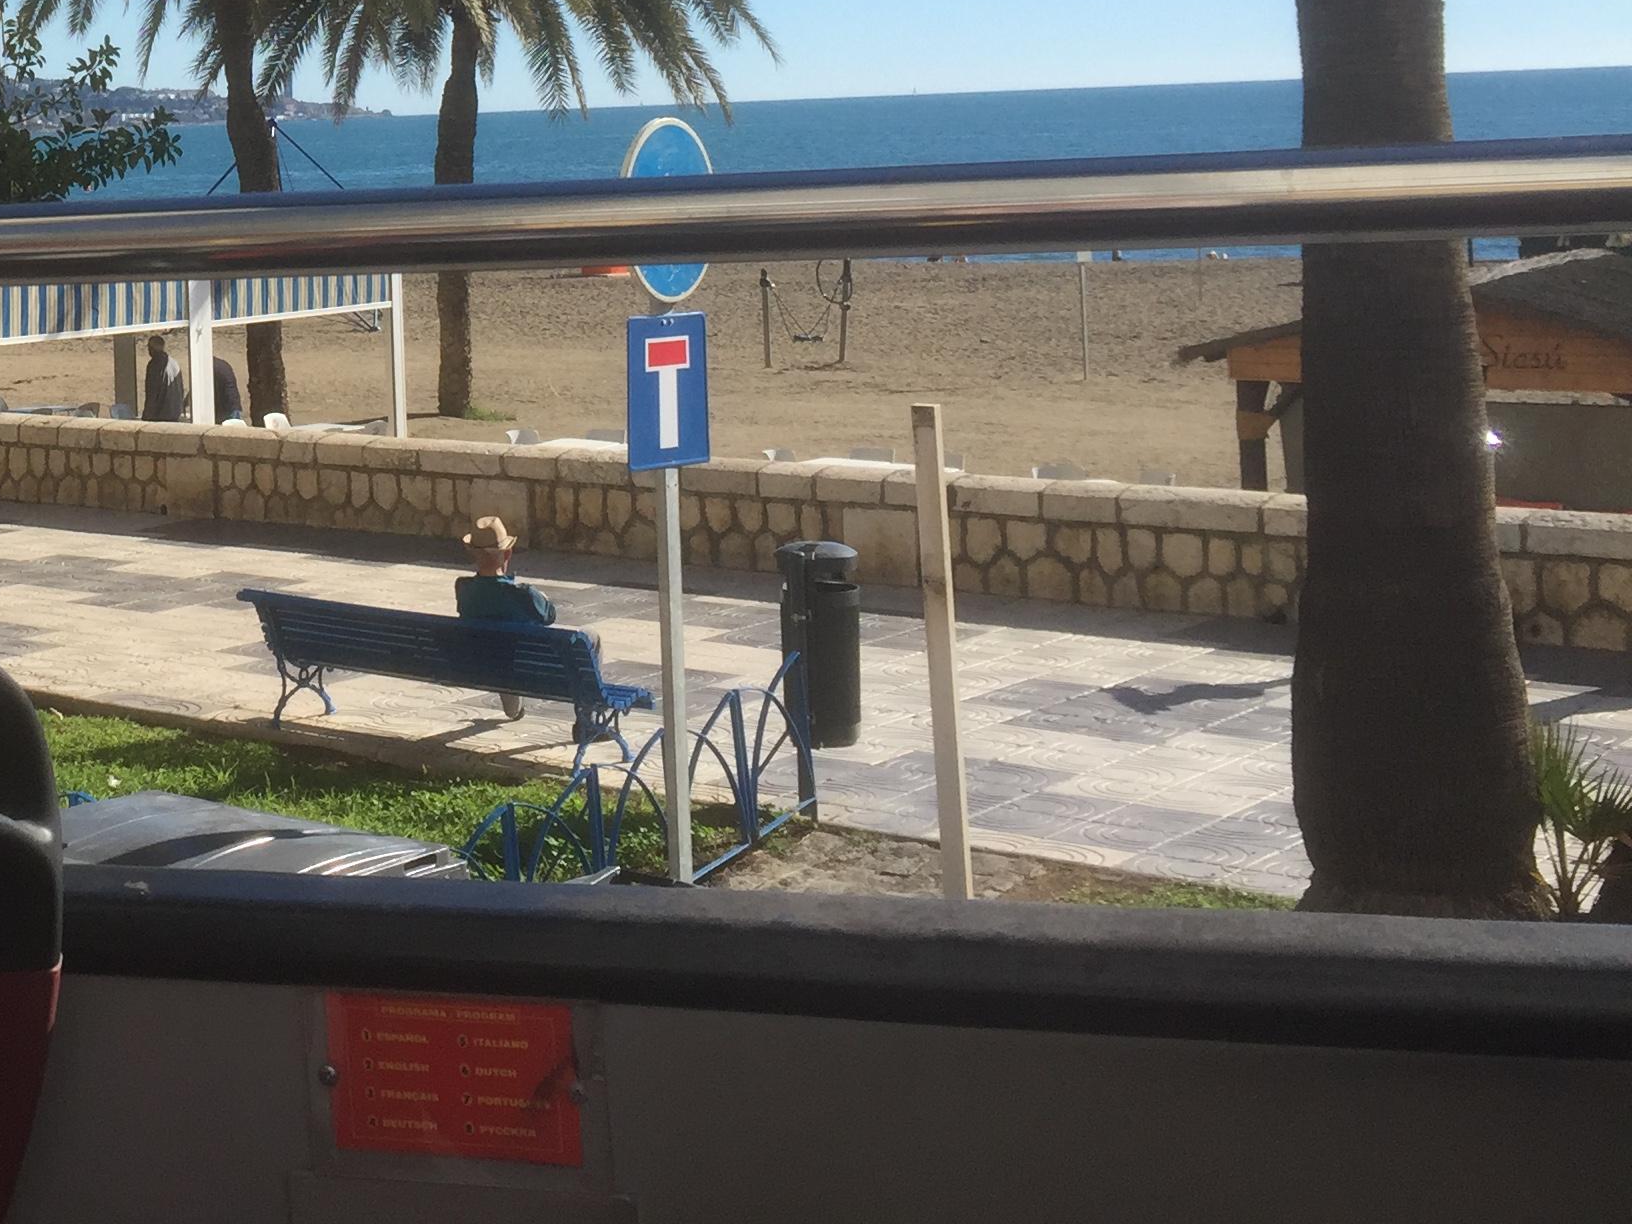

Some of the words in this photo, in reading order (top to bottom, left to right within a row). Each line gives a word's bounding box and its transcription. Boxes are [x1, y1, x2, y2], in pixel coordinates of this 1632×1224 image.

[473, 1038, 529, 1049] ITALIANO
[377, 1061, 430, 1073] ENGLISH
[474, 1067, 518, 1078] DUTCH
[382, 1119, 438, 1131] DEUTSCH
